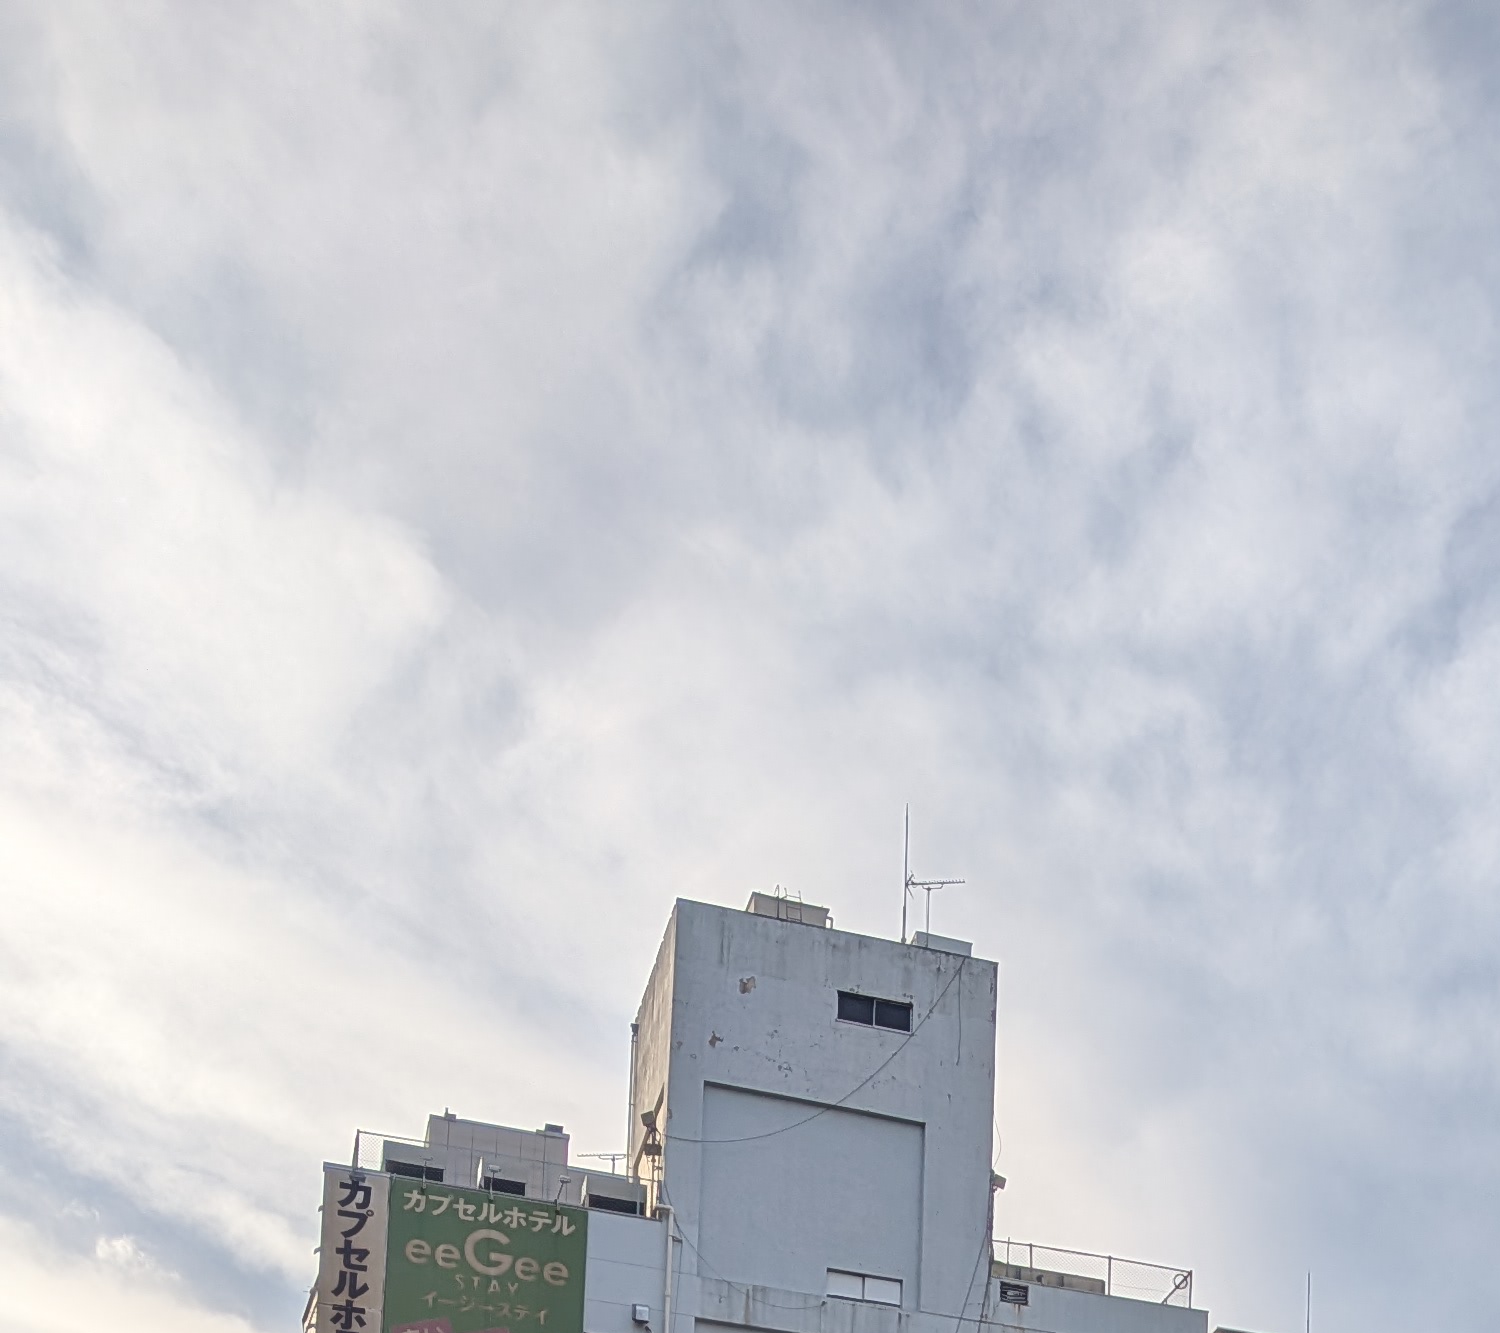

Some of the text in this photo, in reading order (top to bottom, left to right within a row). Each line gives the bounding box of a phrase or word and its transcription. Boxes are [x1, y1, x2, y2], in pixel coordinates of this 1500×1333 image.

[403, 1190, 575, 1236] カプセルホテル
[405, 1229, 568, 1286] eeGee
